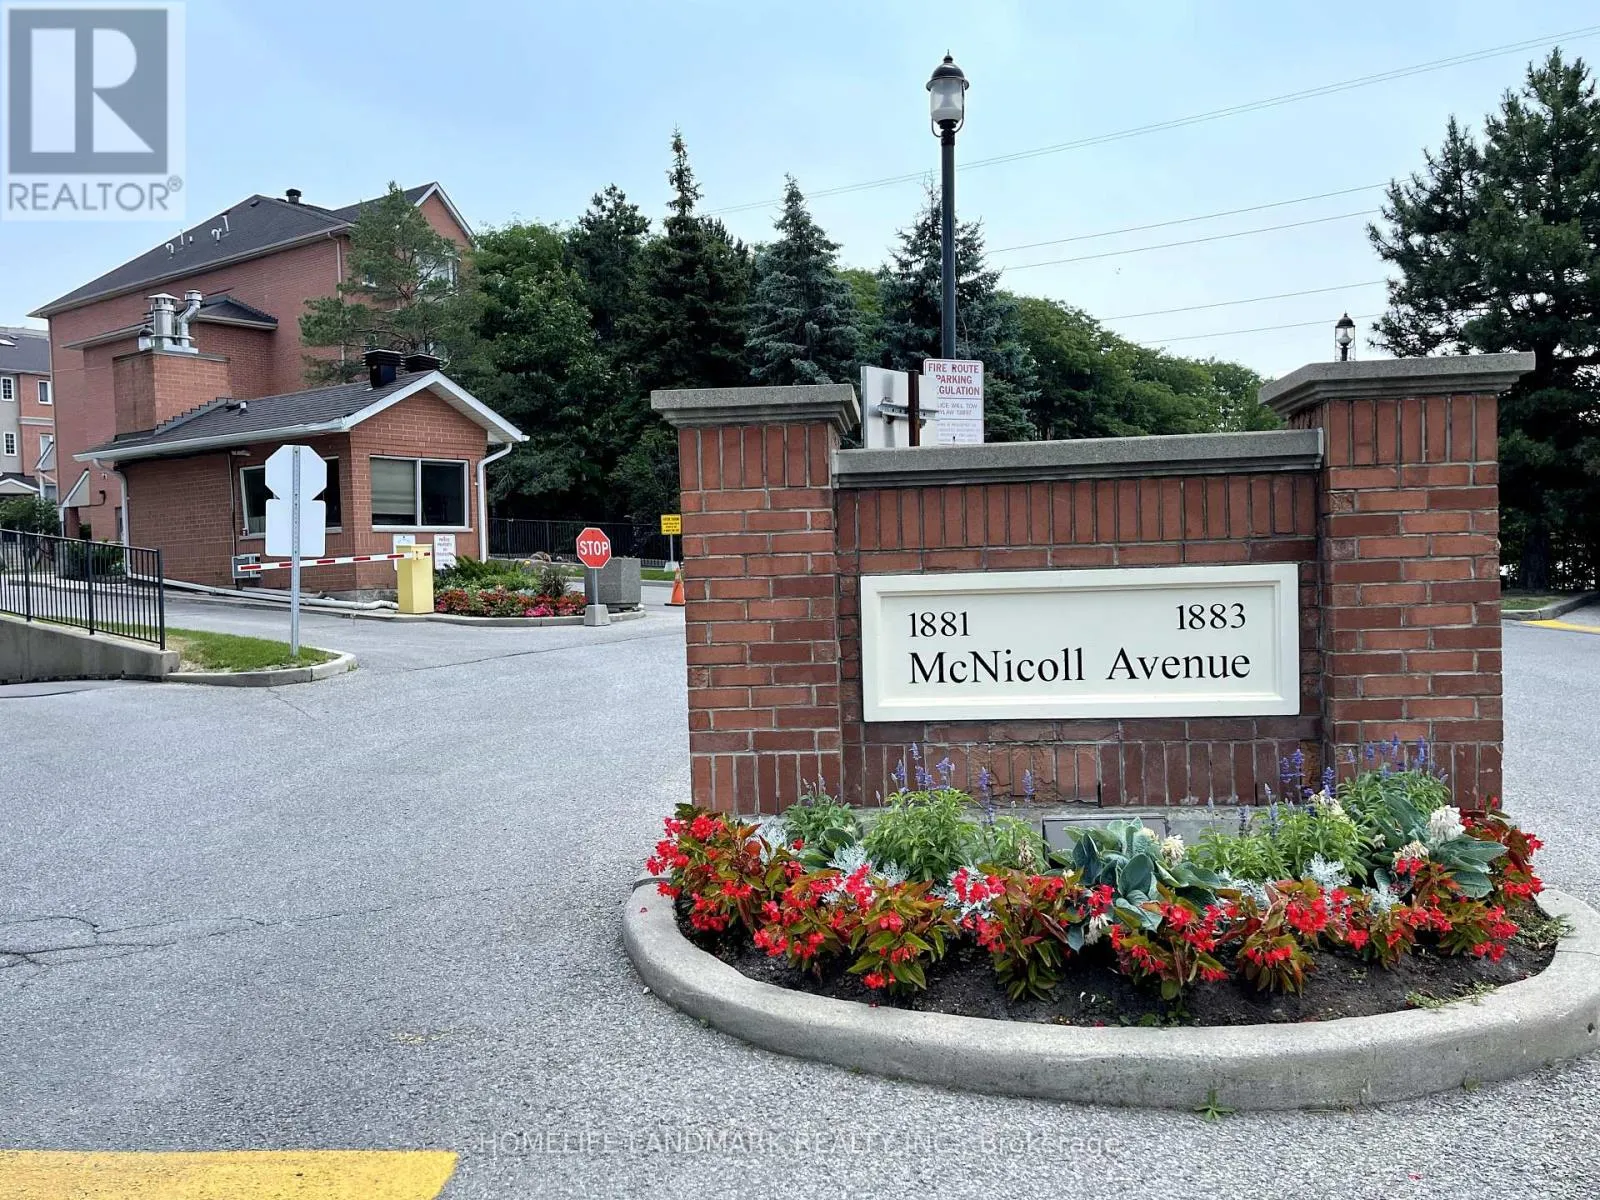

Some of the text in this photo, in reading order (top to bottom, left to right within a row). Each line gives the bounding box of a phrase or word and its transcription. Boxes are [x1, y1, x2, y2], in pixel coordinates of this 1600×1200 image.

[928, 363, 979, 373] FIRE ROUTE
[937, 386, 980, 395] GULATION
[580, 541, 609, 556] STOP
[907, 602, 1247, 638] 1881 1883
[908, 647, 1251, 685] McNicoll Avenue
